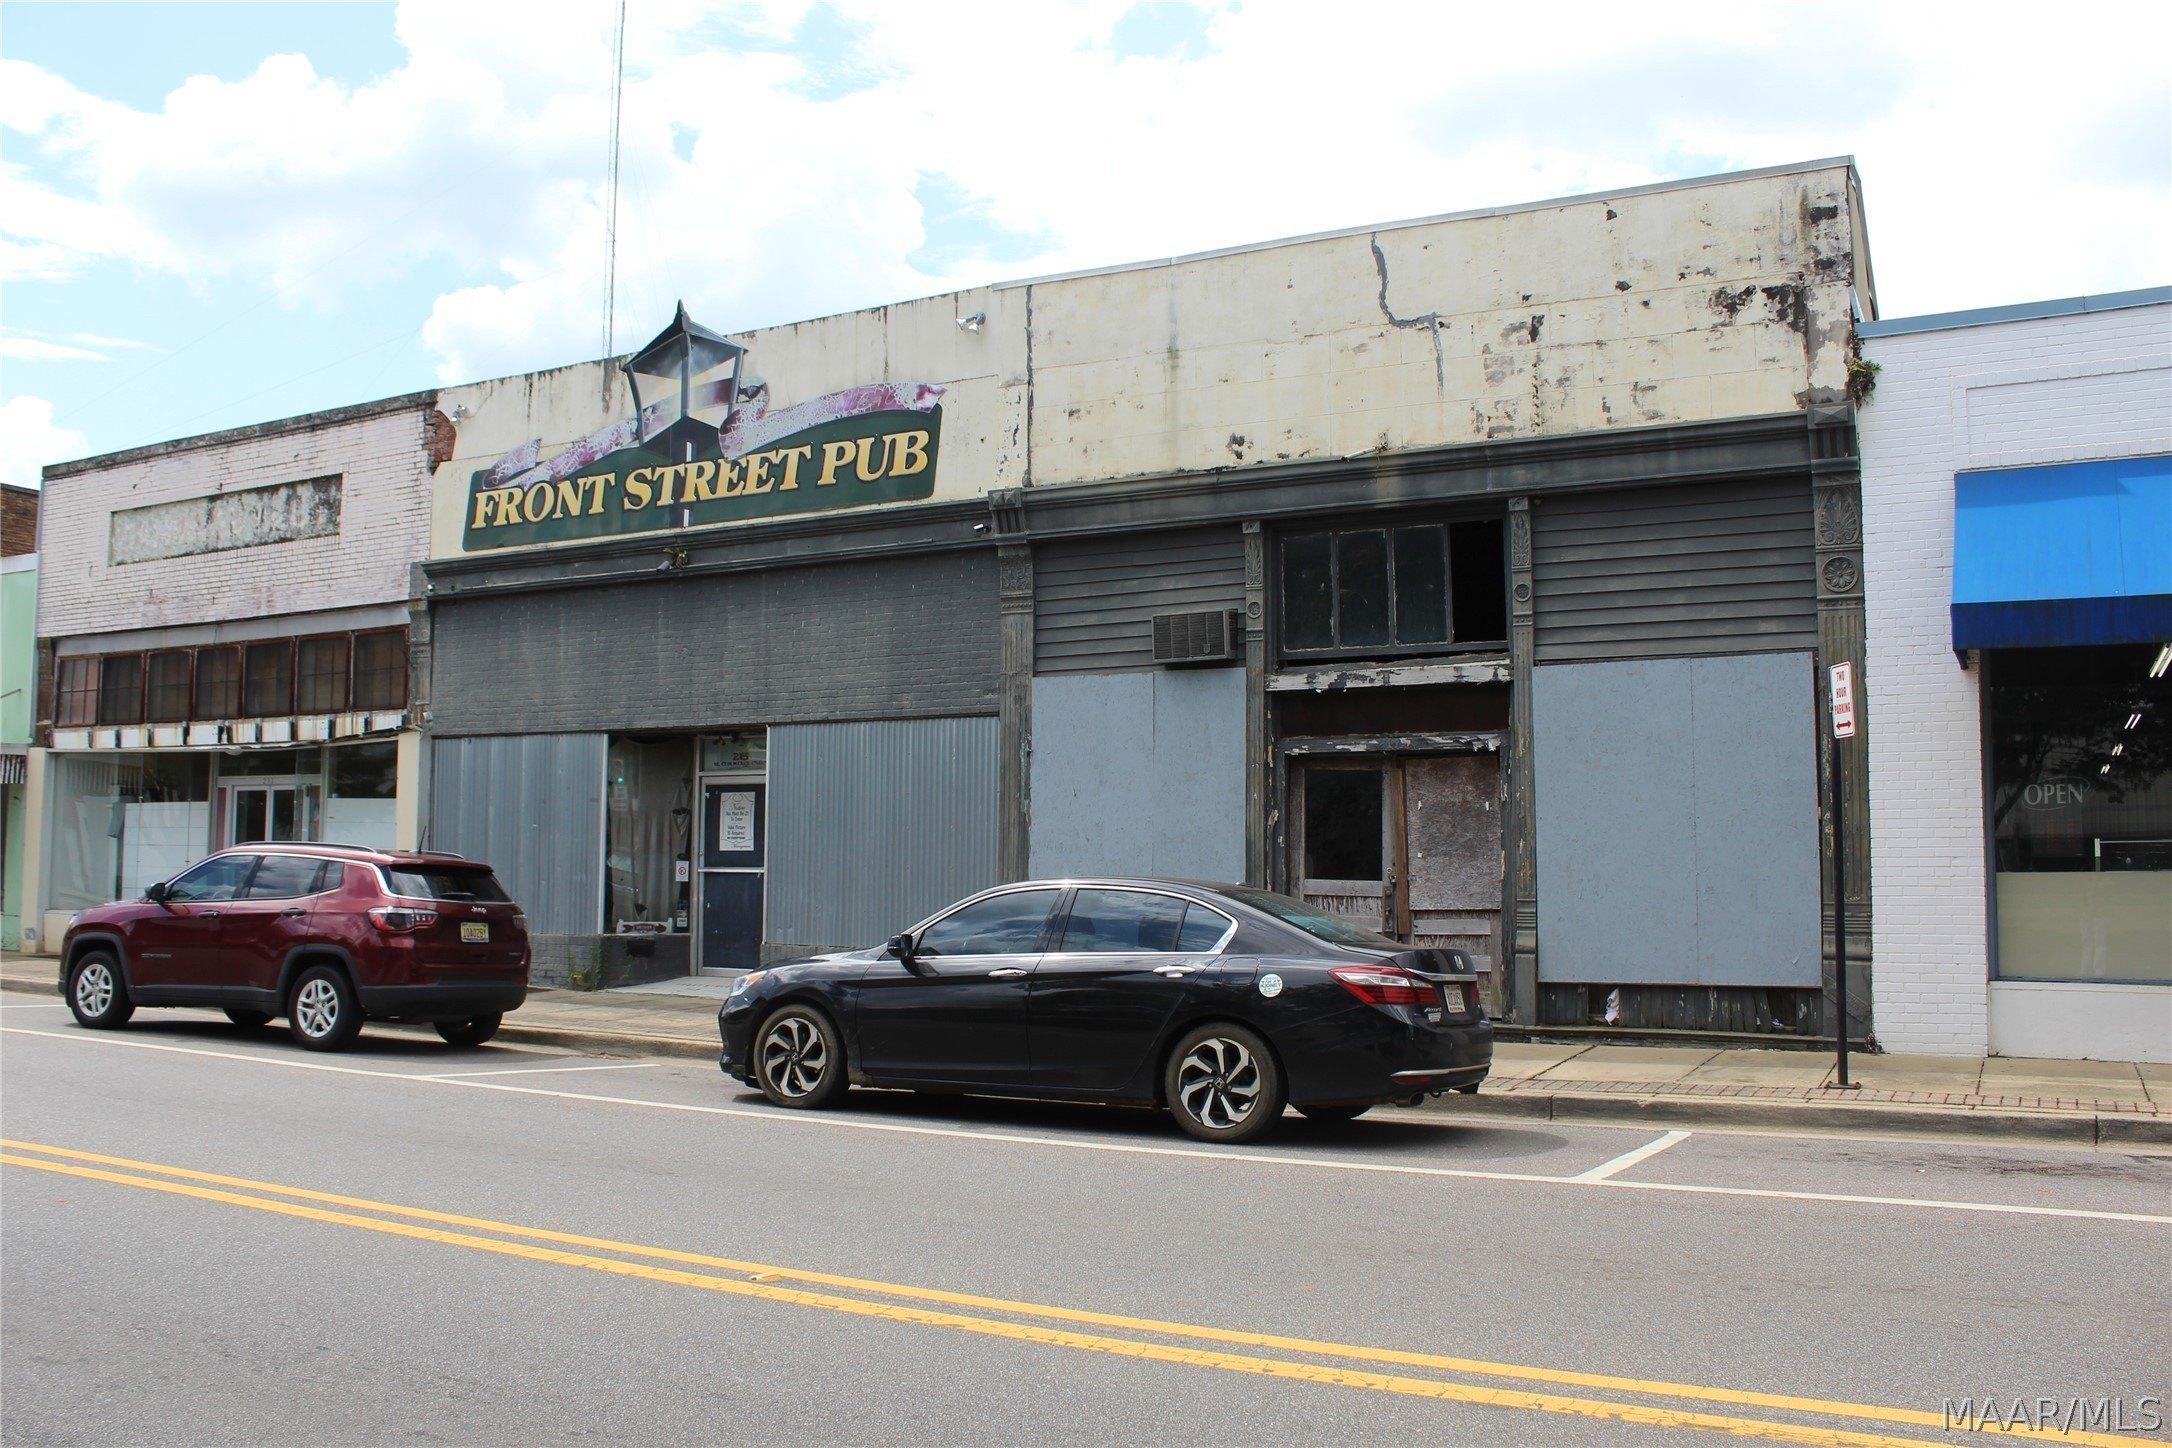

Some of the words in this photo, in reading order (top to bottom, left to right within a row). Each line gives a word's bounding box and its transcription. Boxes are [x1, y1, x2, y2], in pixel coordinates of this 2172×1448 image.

[472, 472, 616, 529] FRONT
[623, 447, 813, 511] STREET
[817, 429, 930, 486] PUB
[1836, 671, 1845, 682] TWO
[1836, 686, 1847, 698] HOUR
[1834, 702, 1851, 715] PARKING
[2024, 782, 2084, 806] OPEN
